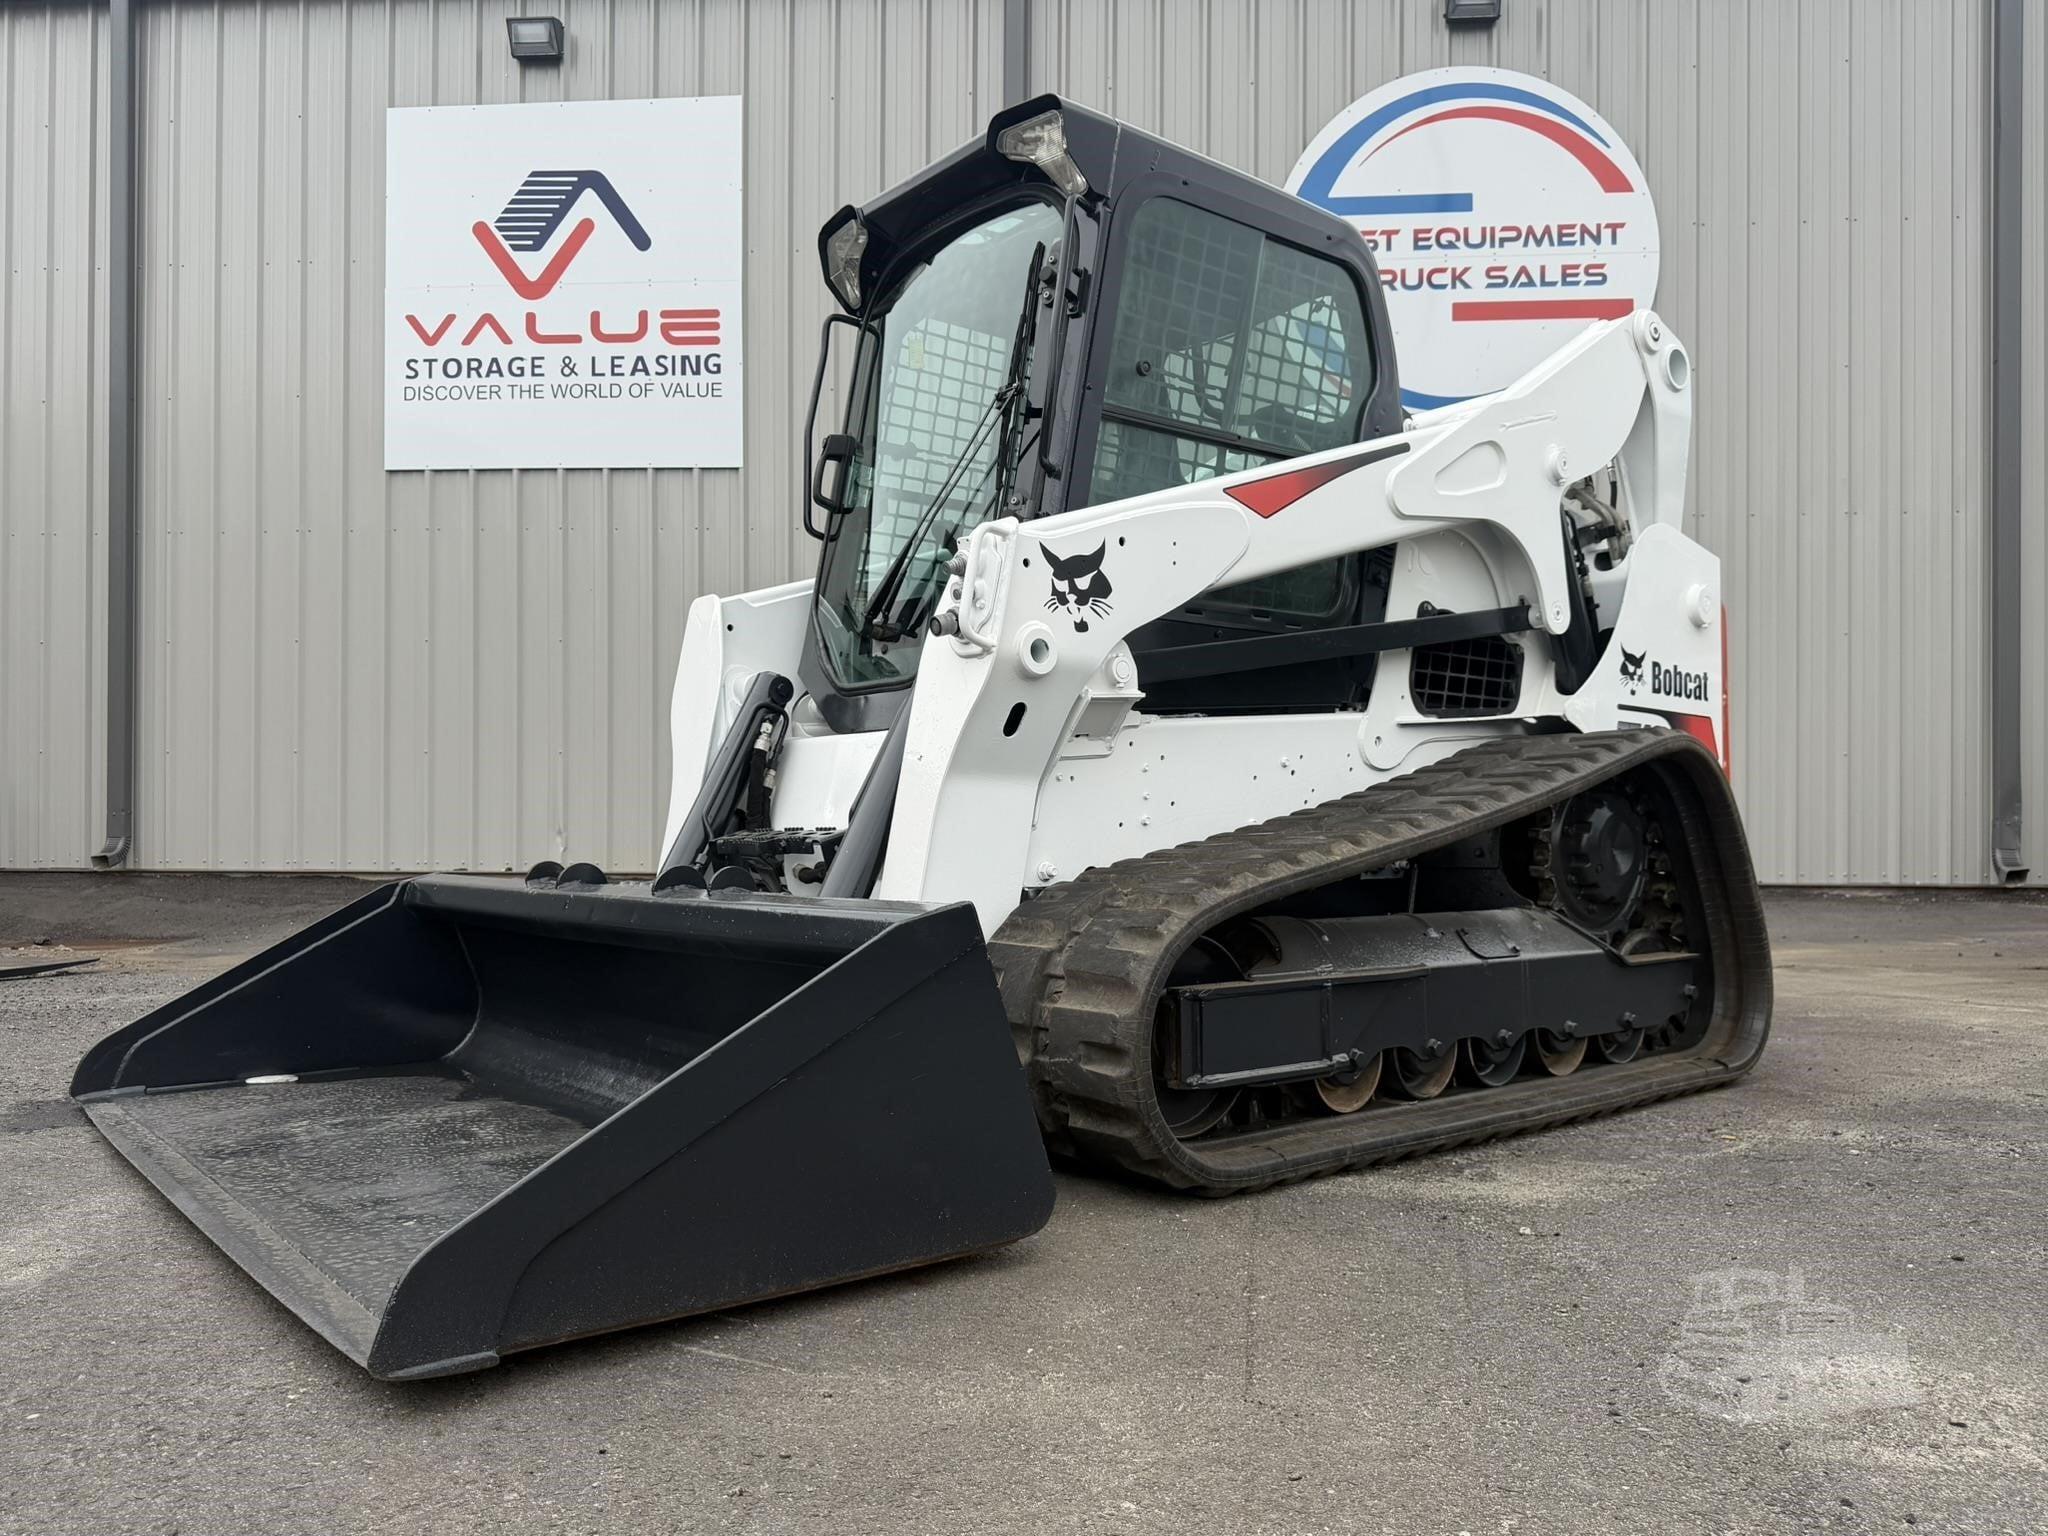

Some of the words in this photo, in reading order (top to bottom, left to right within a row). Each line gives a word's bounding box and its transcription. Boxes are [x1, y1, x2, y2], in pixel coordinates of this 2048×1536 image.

[1412, 222, 1627, 251] EQUIPMENT
[1484, 263, 1609, 289] SALES
[404, 309, 721, 347] VALUE
[404, 356, 546, 380] STORAGE
[560, 355, 579, 378] &
[591, 352, 723, 378] LEASING
[403, 384, 502, 402] DISCOVER
[506, 383, 545, 400] THE
[550, 382, 623, 400] WORLD
[628, 382, 655, 399] OF
[660, 381, 723, 399] VALUE
[1651, 660, 1709, 702] Bobcat
